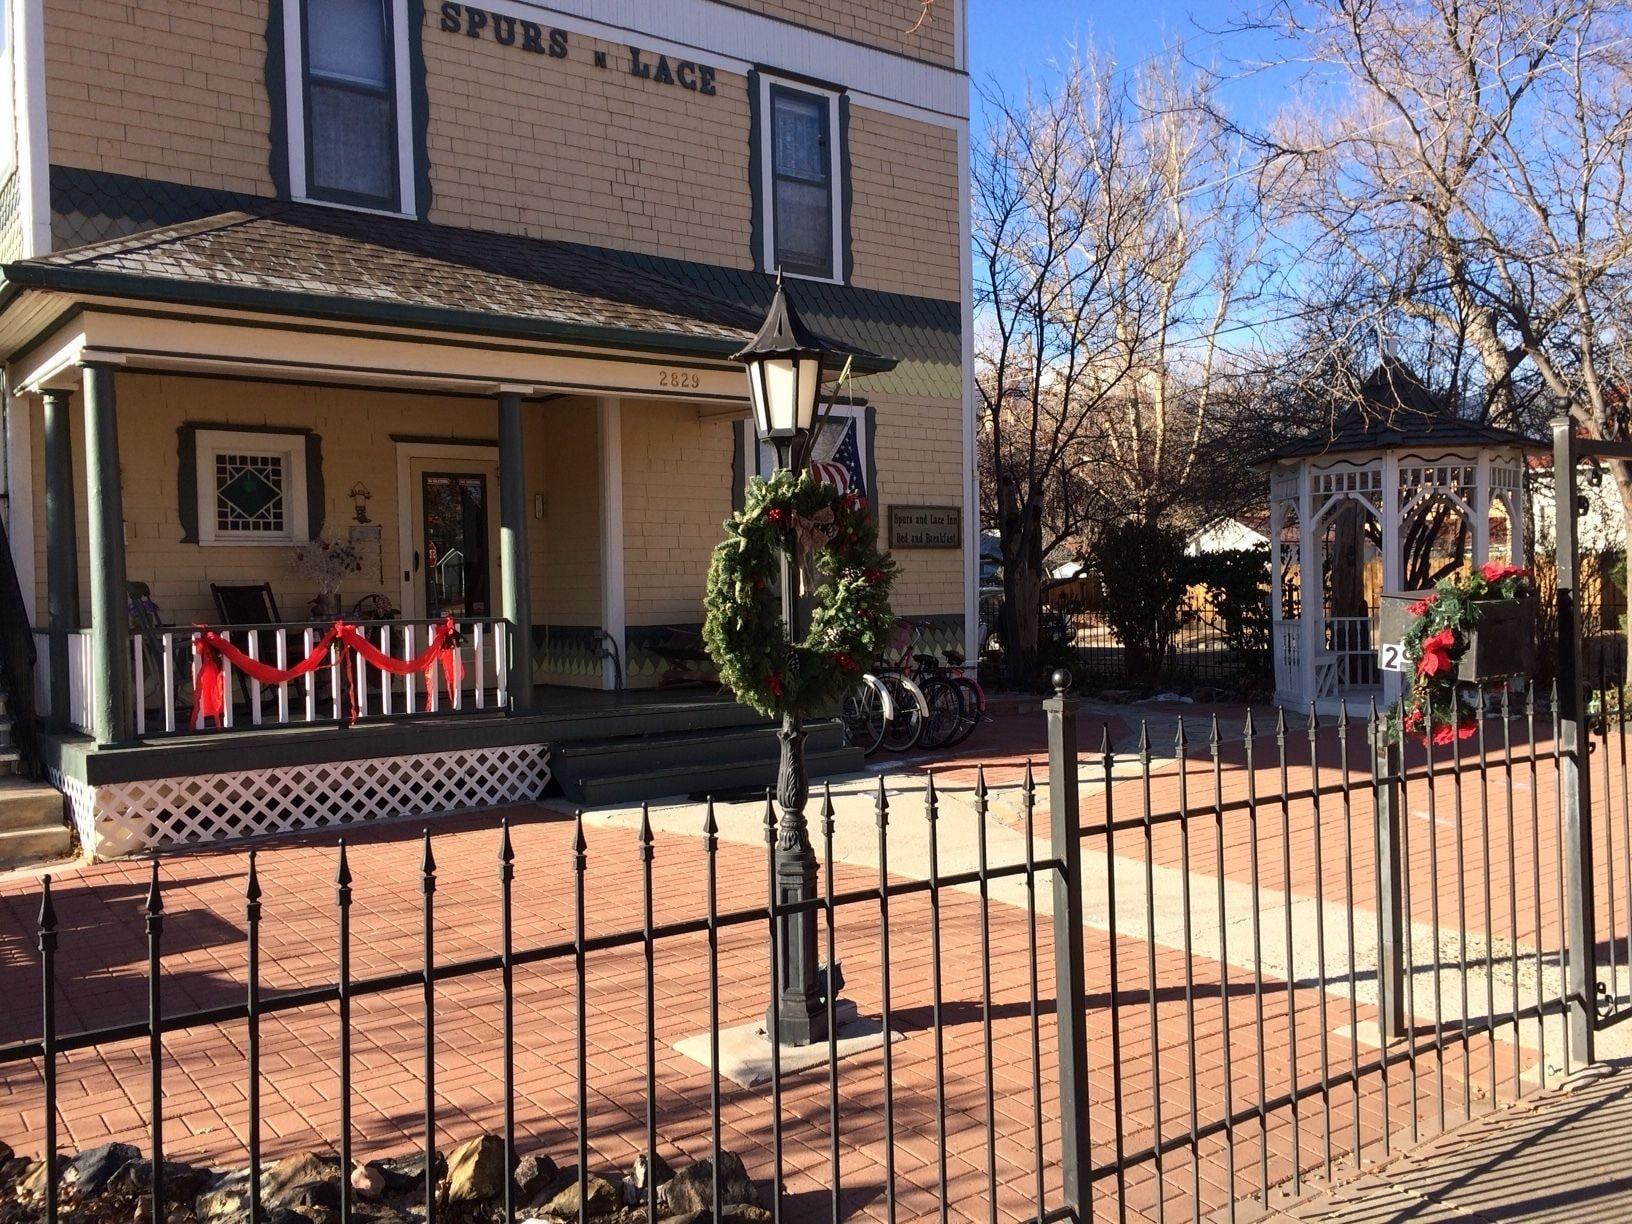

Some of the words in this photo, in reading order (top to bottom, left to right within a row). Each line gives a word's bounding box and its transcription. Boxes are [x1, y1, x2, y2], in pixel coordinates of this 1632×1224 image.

[441, 1, 568, 58] SPURS
[629, 46, 717, 96] LACE
[659, 371, 700, 388] 2829
[894, 513, 913, 527] Spurs
[915, 513, 928, 525] and
[930, 514, 945, 525] Lace
[946, 514, 958, 525] Inn
[896, 532, 908, 543] Bed
[911, 532, 923, 543] and
[925, 532, 956, 544] Breakfast
